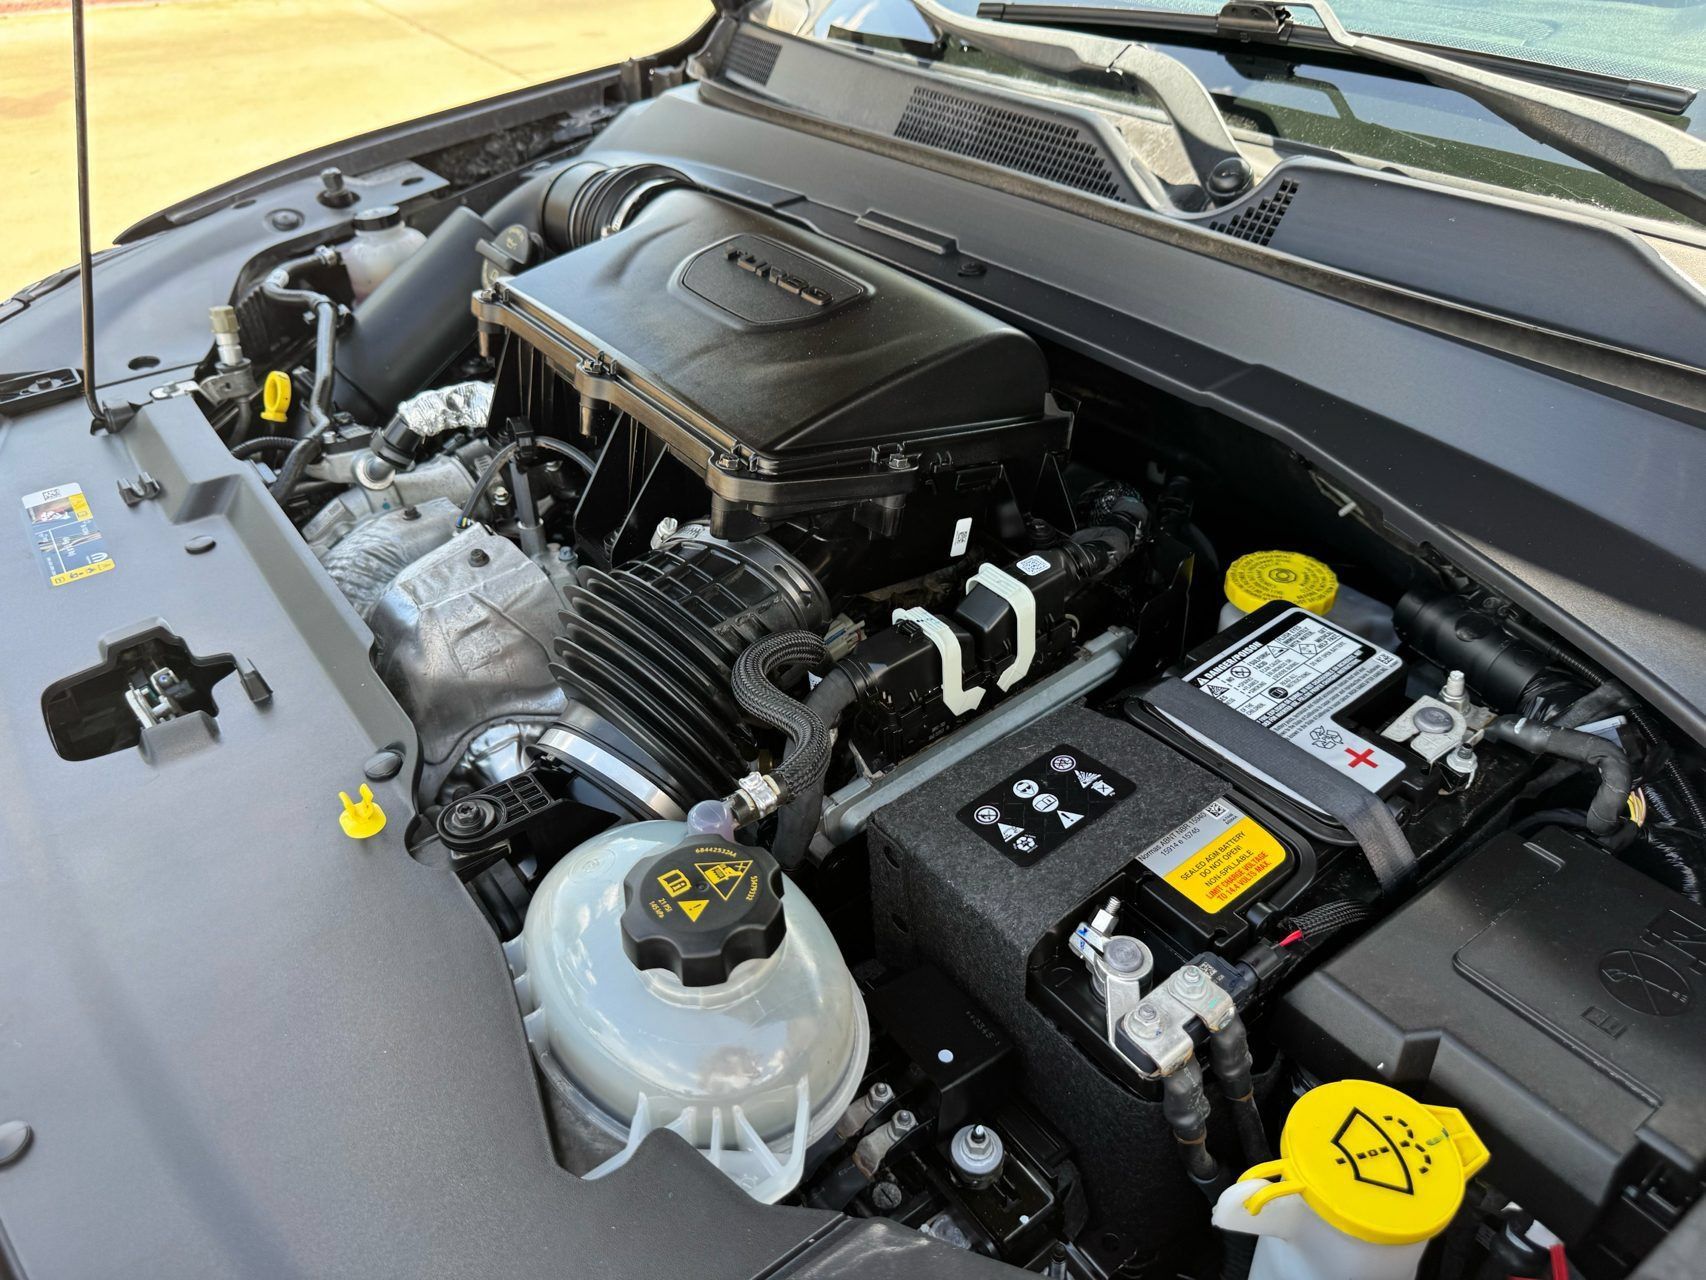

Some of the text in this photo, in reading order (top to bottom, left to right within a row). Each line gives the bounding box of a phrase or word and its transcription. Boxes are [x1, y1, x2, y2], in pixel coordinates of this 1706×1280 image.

[725, 245, 834, 306] TURBO
[1275, 625, 1302, 641] FLUSH EYES
[1281, 626, 1310, 644] IMMEDIATELY
[1314, 630, 1334, 643] MEDICAL
[1316, 640, 1330, 648] HELP
[1202, 641, 1264, 679] DANGER/POISON
[1137, 843, 1162, 861] Normas
[1158, 832, 1177, 846] ABNT
[1174, 822, 1191, 834] NBR
[1188, 811, 1207, 825] 15940
[1159, 841, 1179, 856] 15914
[1181, 826, 1200, 840] 15745
[1179, 831, 1246, 881] SEALED AGM BATTERY
[1198, 844, 1243, 877] DO NOT OPEN!
[1204, 849, 1254, 887] NON-SPILLABLE
[1205, 851, 1268, 899] LIMIT CHARGE VOLTAGE
[1217, 859, 1272, 901] TO 14.4 VOLTS MAX.
[663, 903, 673, 913] PSI
